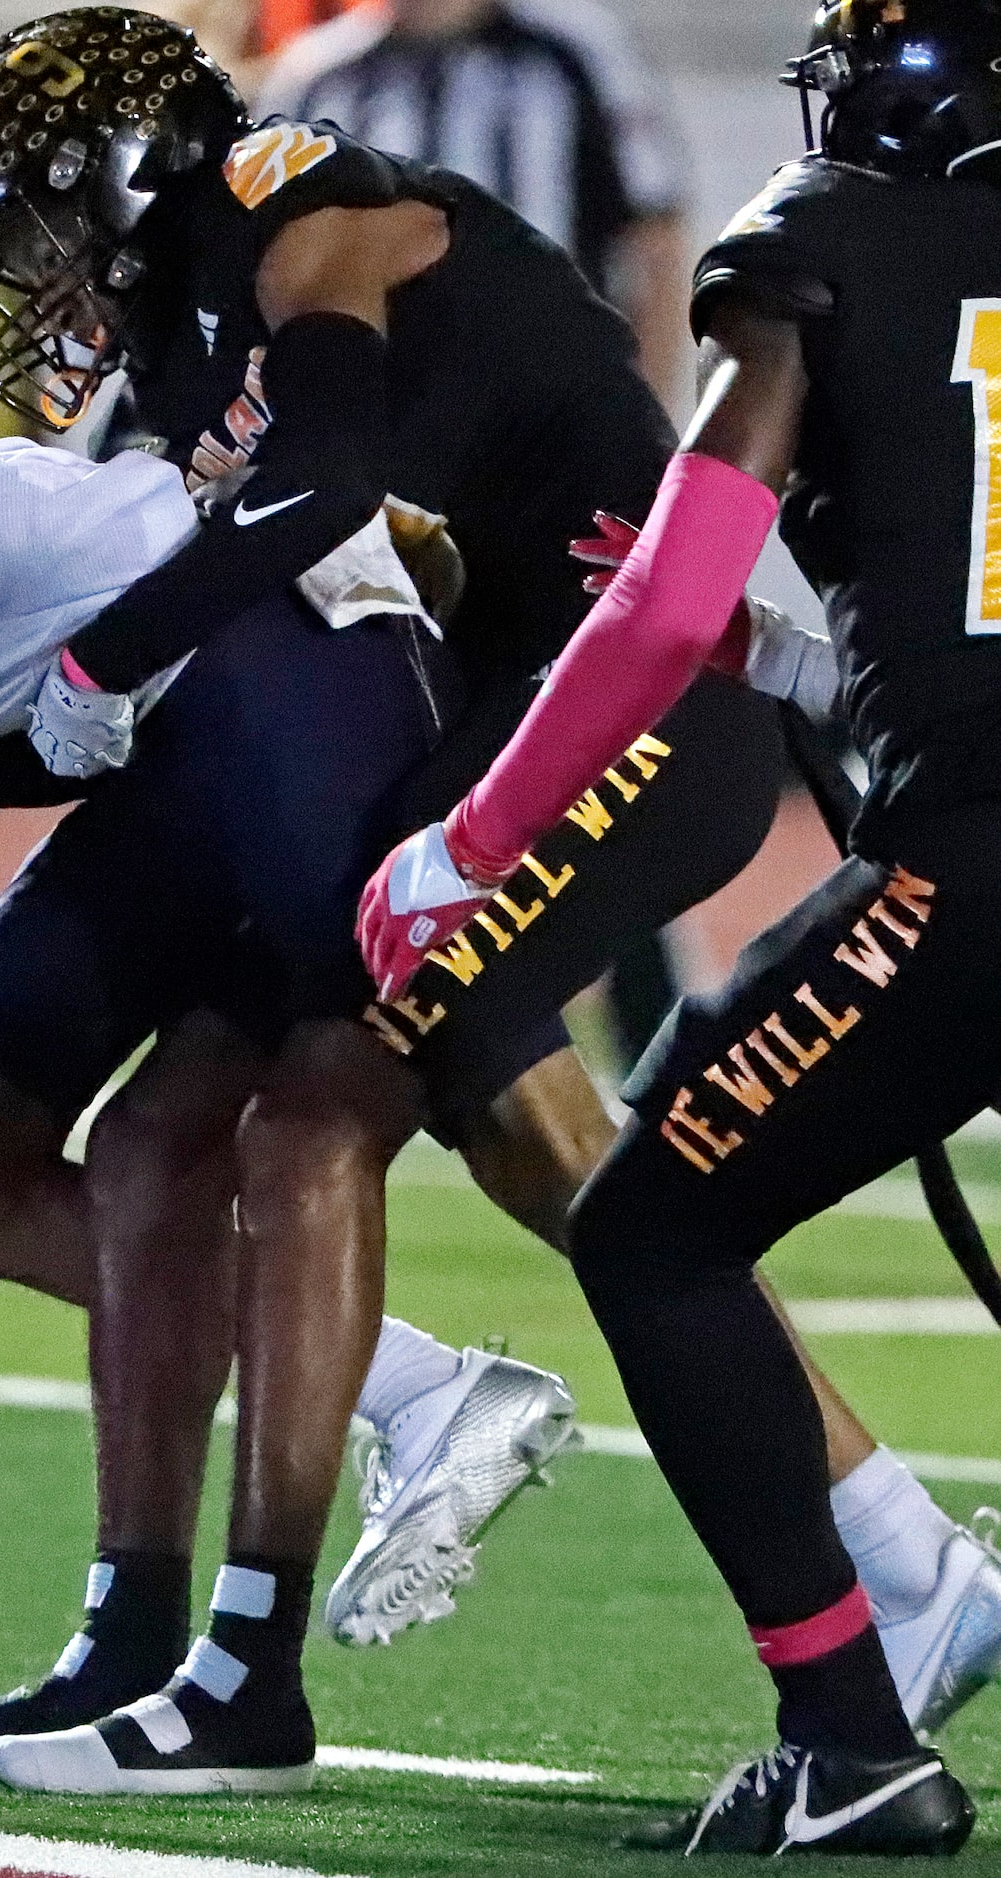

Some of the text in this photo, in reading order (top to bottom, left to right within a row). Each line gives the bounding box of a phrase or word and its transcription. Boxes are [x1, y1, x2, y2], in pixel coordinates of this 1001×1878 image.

[423, 852, 575, 987] WILL
[564, 732, 673, 842] WIN
[703, 982, 862, 1116] WILL
[833, 863, 936, 988] WIN
